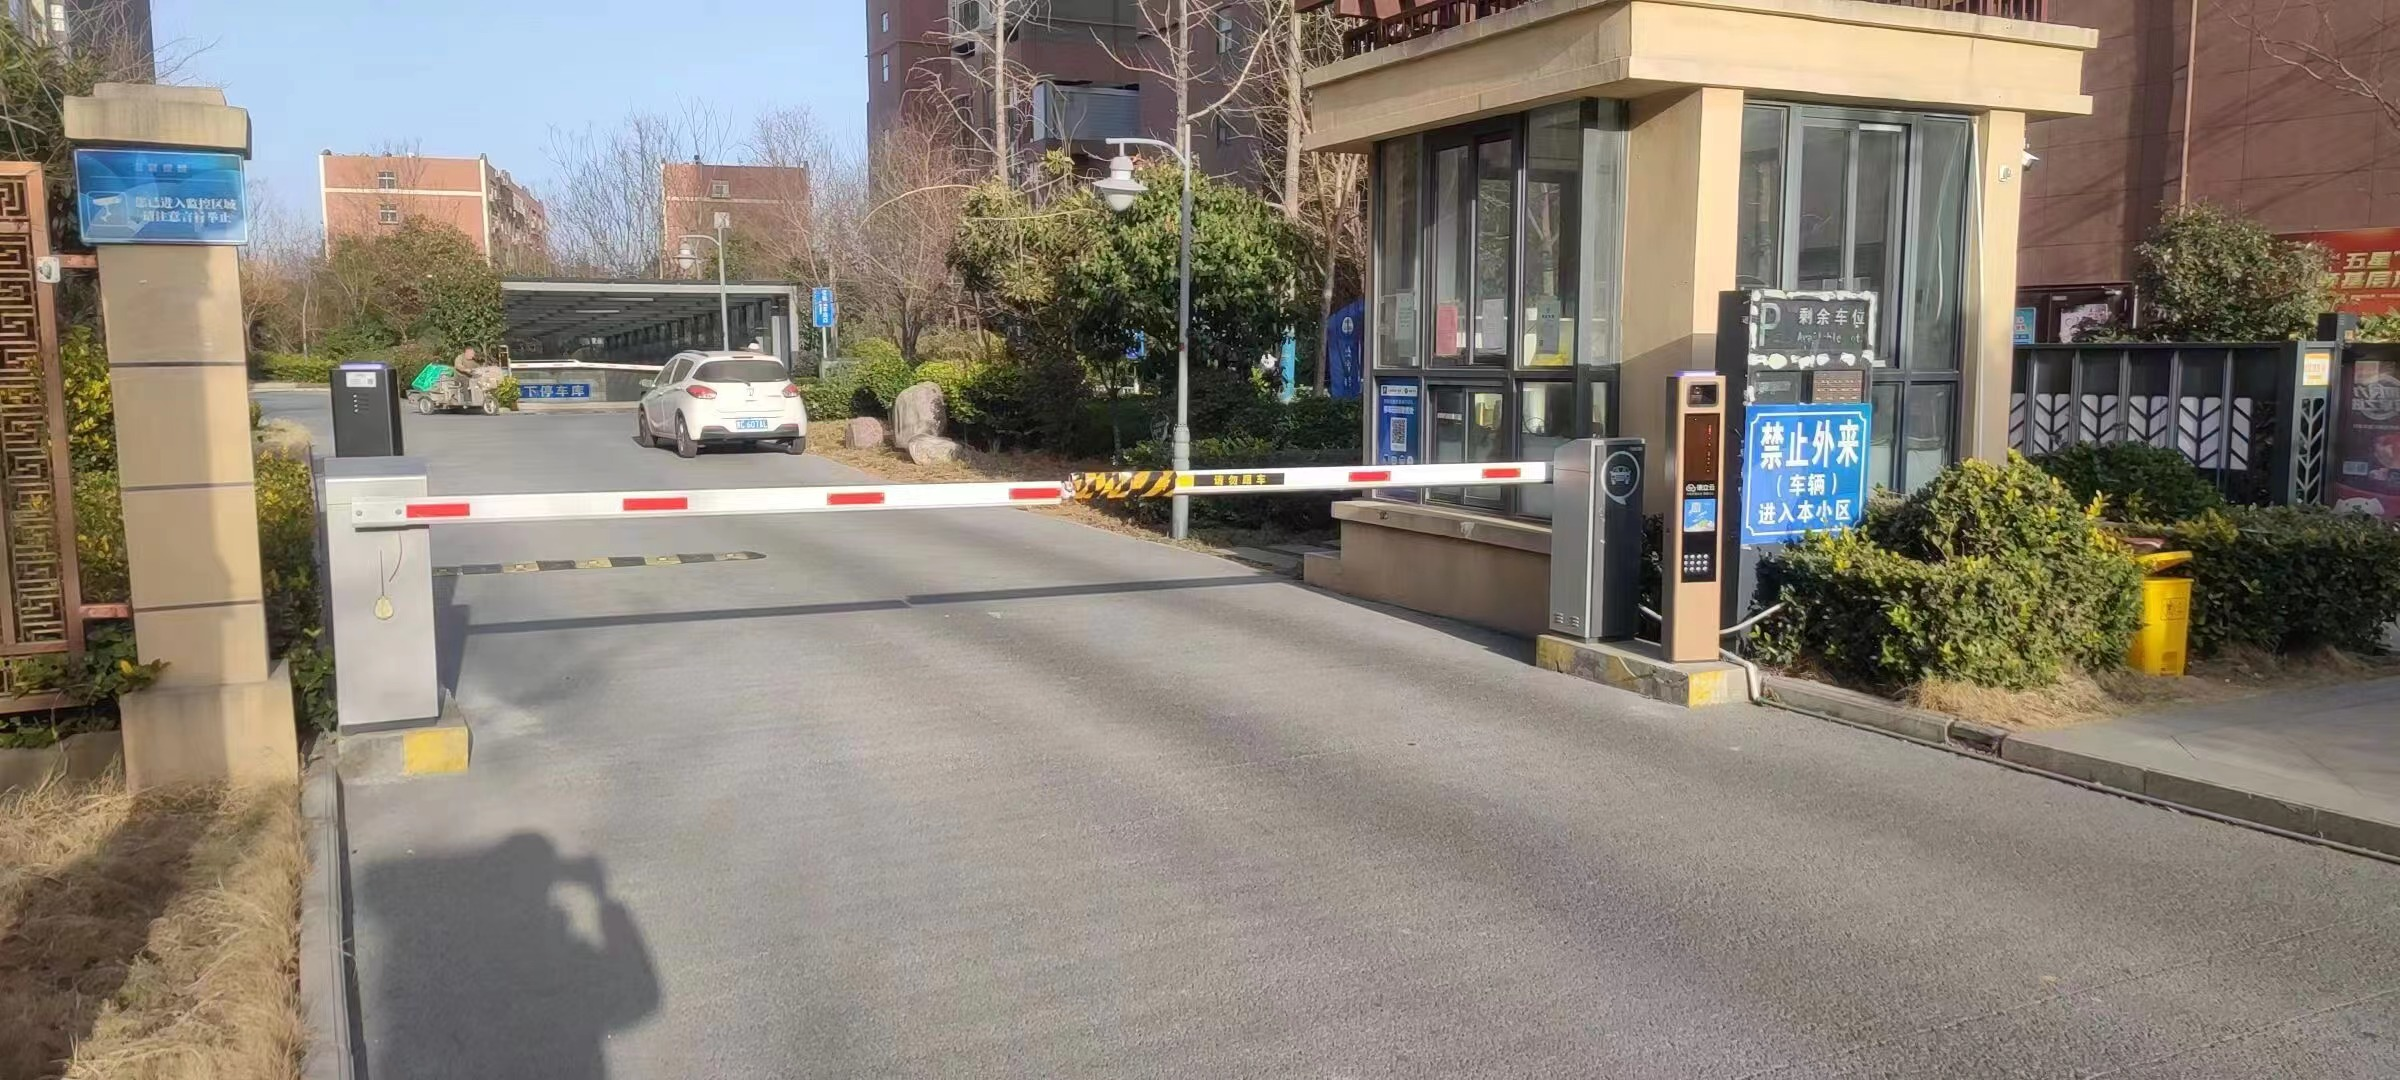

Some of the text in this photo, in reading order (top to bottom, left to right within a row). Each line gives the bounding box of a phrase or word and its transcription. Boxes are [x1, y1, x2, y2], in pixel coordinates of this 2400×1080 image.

[1759, 302, 1780, 346] P
[1799, 307, 1865, 327] 剩余车位
[517, 385, 585, 398] 下停车库
[1760, 419, 1860, 470] 禁止外来
[1758, 499, 1851, 525] 进入本小区
